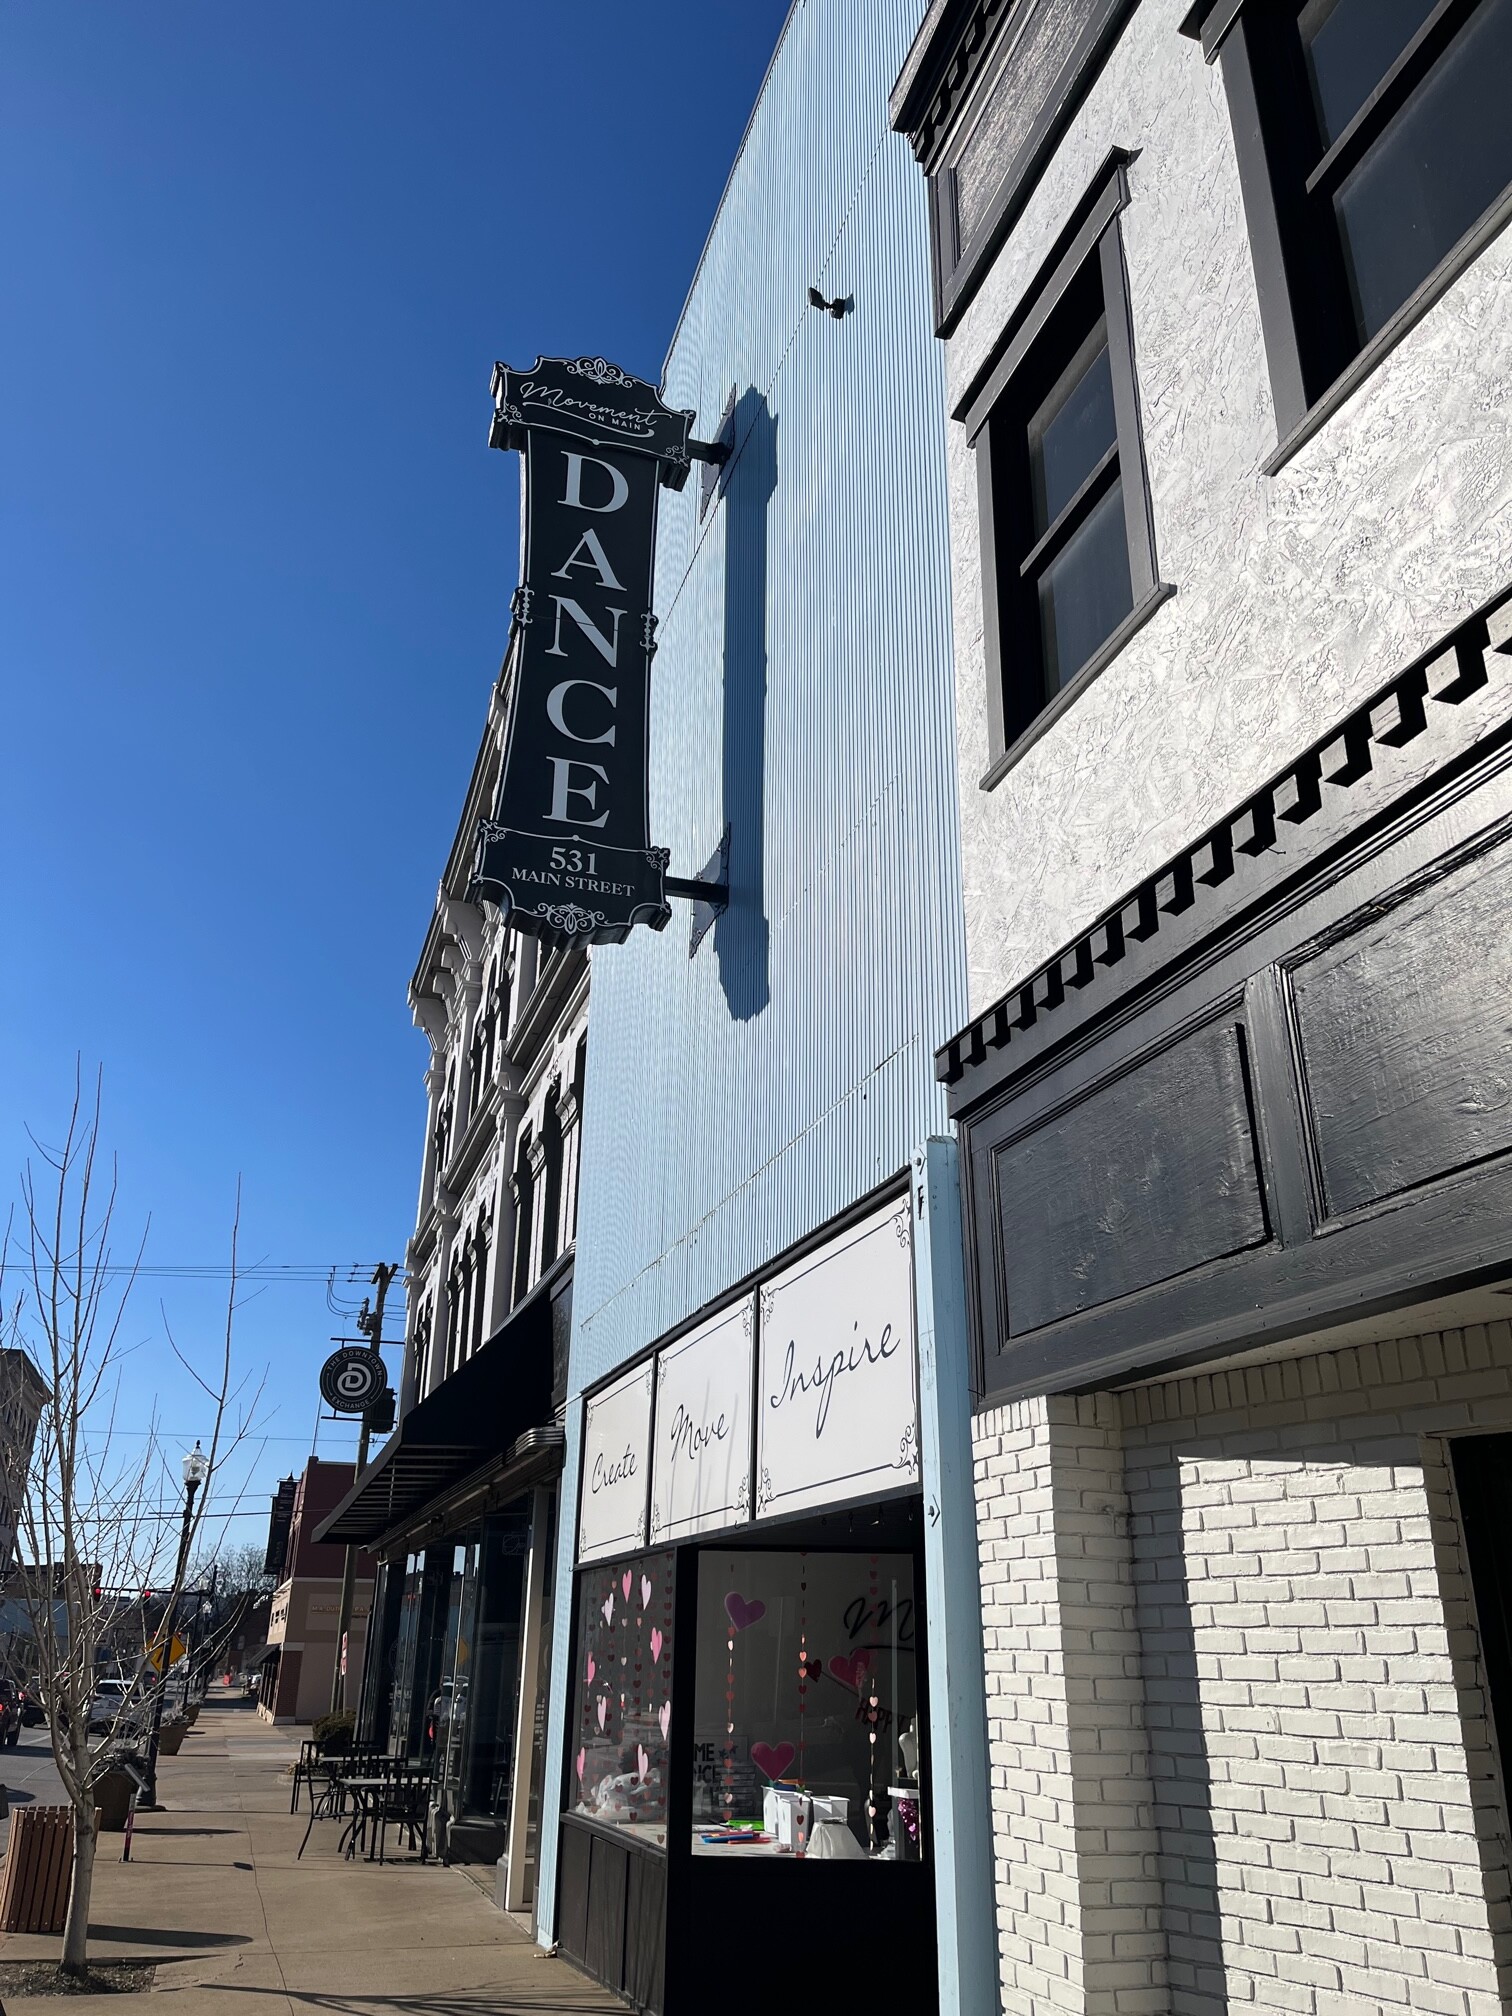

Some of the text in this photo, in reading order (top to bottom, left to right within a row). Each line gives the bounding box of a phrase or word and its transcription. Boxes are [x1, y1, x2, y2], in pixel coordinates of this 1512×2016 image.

[519, 381, 673, 426] Movement
[588, 412, 642, 431] ON MAIN
[542, 450, 629, 829] DANCE
[549, 846, 599, 875] 531
[511, 867, 636, 897] MAIN STREET
[328, 1351, 383, 1376] THE DOWNTOWN
[770, 1321, 901, 1439] Inspire
[332, 1396, 370, 1409] EXCHANGE
[670, 1403, 730, 1463] Move
[591, 1443, 638, 1494] Create
